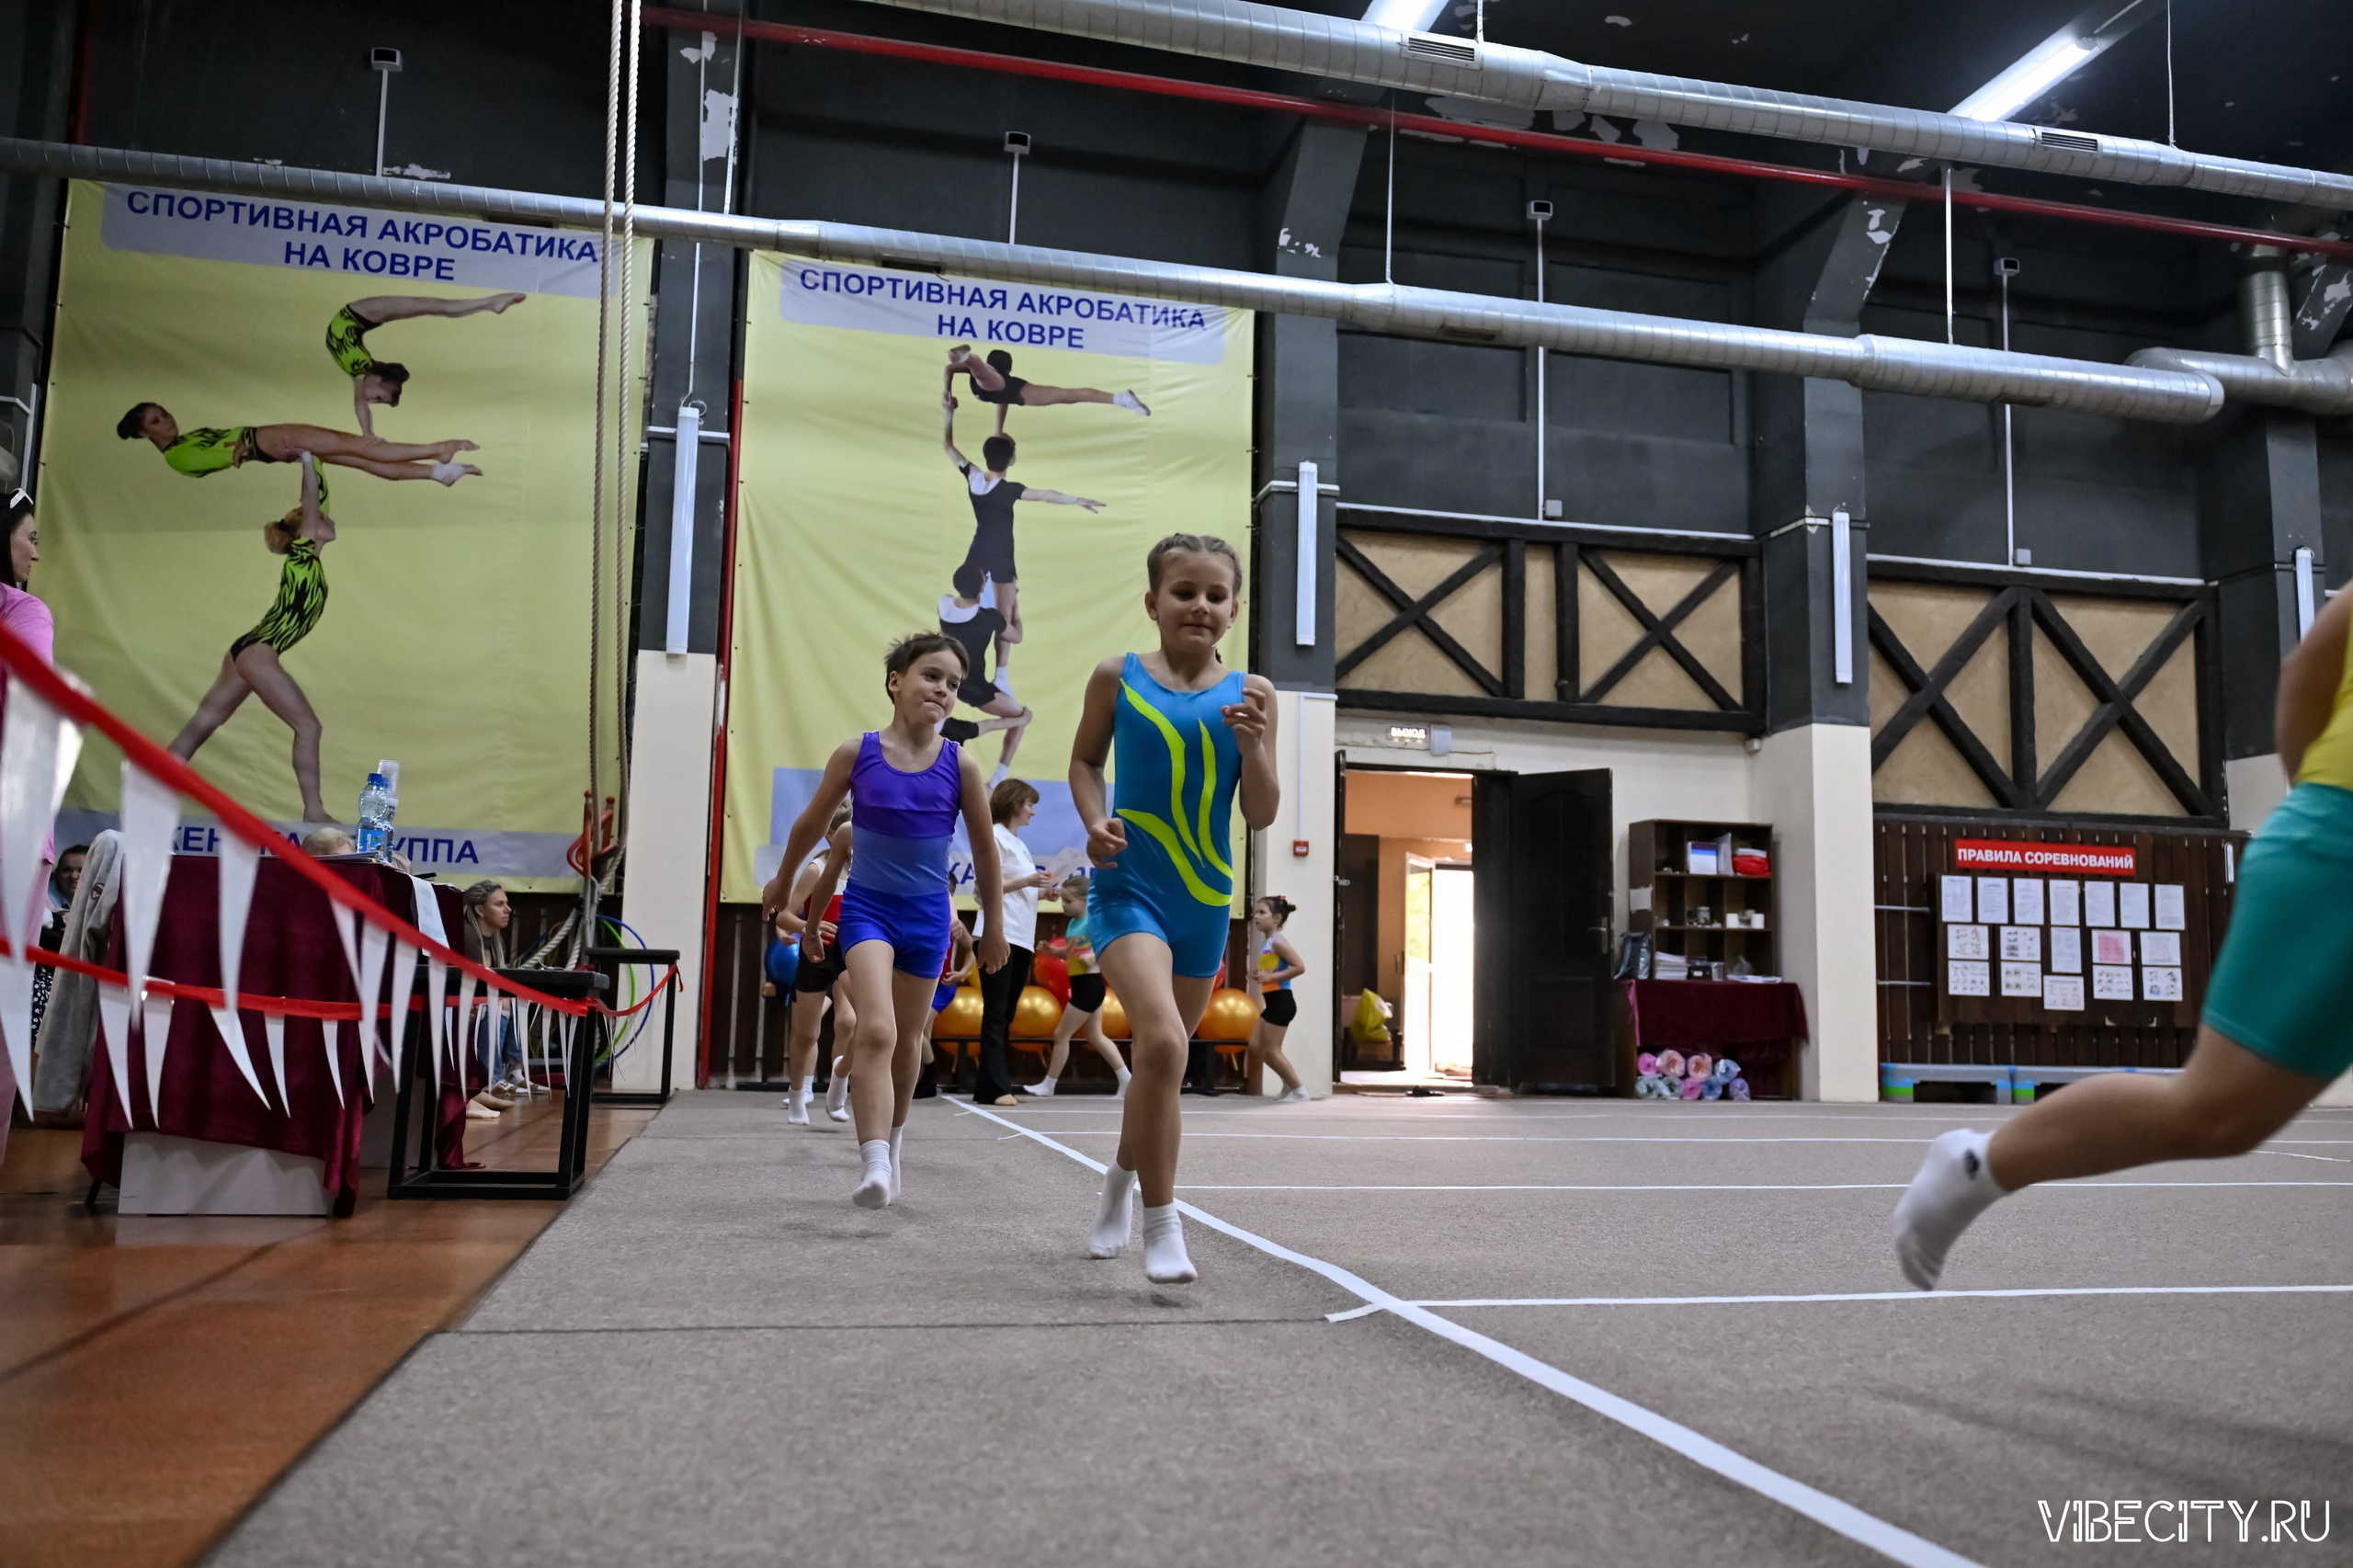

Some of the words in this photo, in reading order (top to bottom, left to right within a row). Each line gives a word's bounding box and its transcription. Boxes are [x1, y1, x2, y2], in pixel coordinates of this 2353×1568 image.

[127, 190, 368, 238] СПОРТИВНАЯ
[377, 219, 598, 263] АКРОБАТИКА
[284, 241, 331, 268] НА
[342, 247, 456, 280] КОВРЕ
[800, 268, 1007, 311] СПОРТИВНАЯ
[1017, 291, 1207, 331] АКРОБАТИКА
[938, 313, 978, 339] НА
[987, 319, 1084, 349] КОВРЕ
[1391, 727, 1427, 739] ВЫХОД
[1957, 847, 2022, 864] ПРАВИЛА
[2024, 850, 2134, 869] СОРЕВНОВАНИЙ
